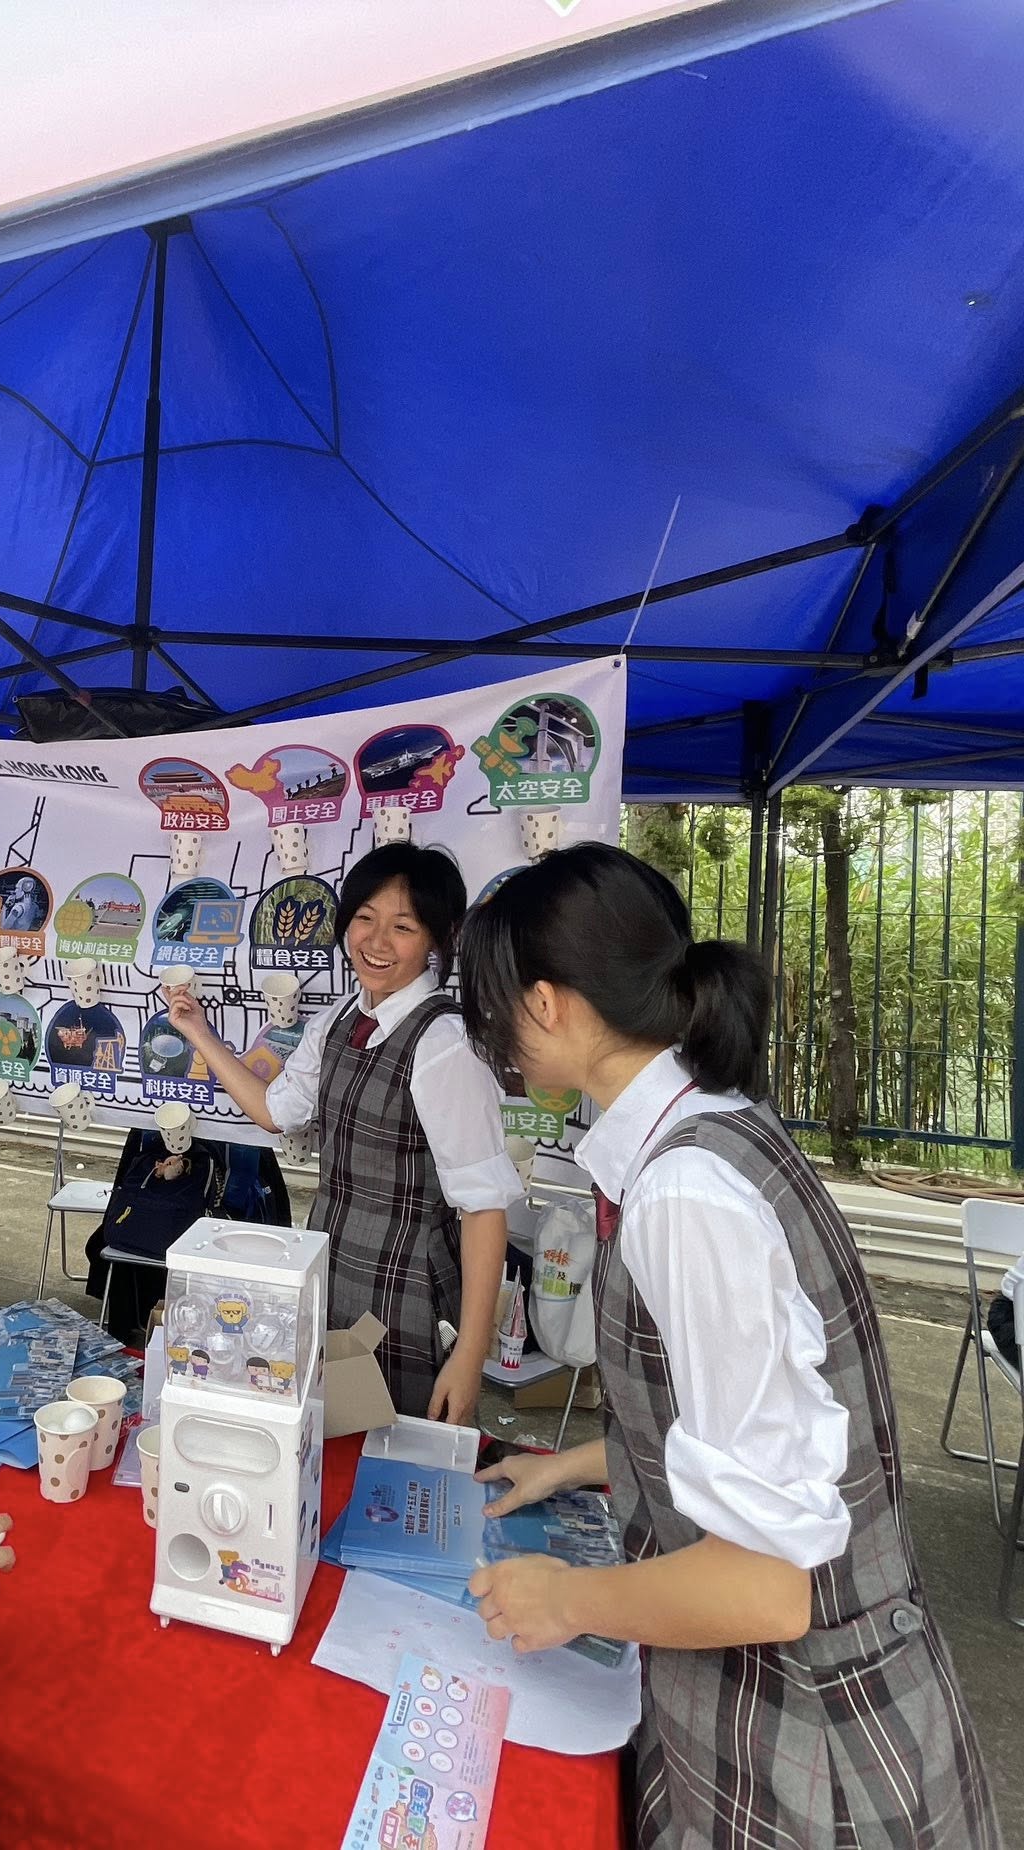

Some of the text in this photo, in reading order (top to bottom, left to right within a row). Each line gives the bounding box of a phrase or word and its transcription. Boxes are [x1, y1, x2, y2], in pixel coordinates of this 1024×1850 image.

[5, 760, 57, 778] HONG
[53, 764, 108, 783] KONG
[495, 779, 583, 801] 太空安全
[163, 812, 228, 831] 政治安全
[272, 801, 337, 824] 國土安全
[59, 940, 134, 959] 海外利益安全
[156, 946, 219, 964] 網絡安全
[256, 949, 329, 968] 糧食安全
[54, 1067, 113, 1091] 資源安全
[146, 1079, 211, 1102] 科技安全
